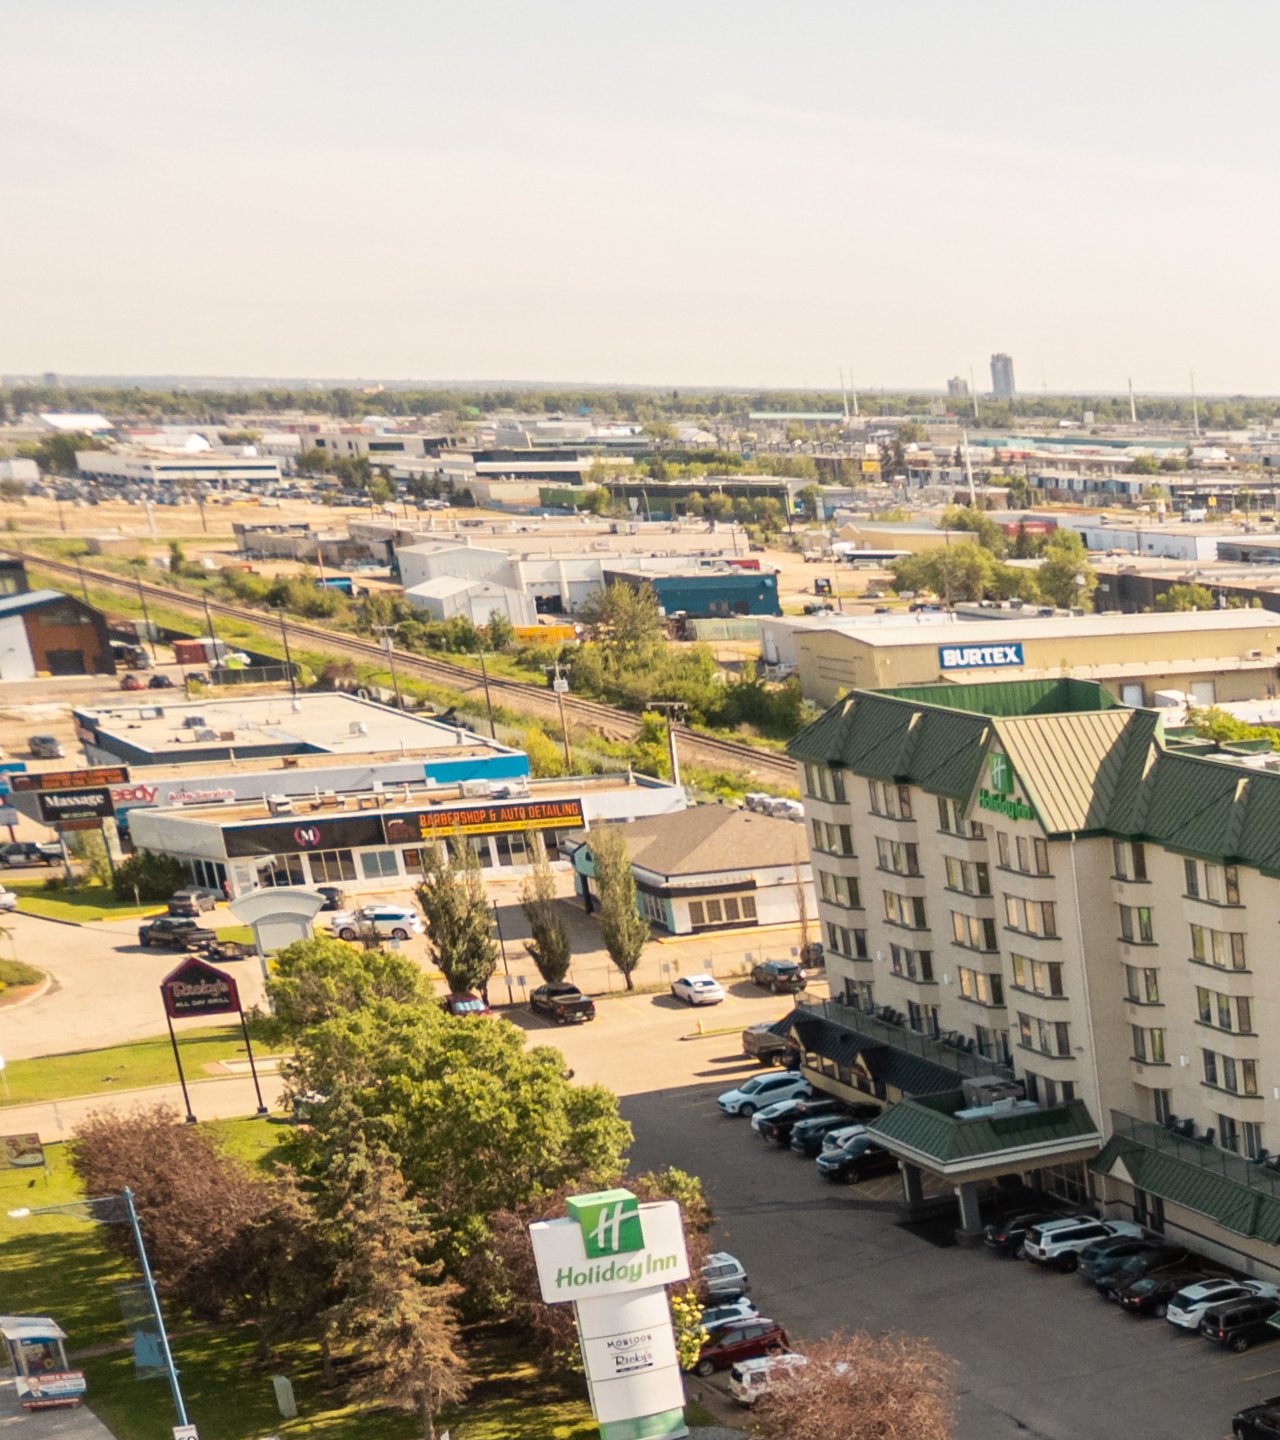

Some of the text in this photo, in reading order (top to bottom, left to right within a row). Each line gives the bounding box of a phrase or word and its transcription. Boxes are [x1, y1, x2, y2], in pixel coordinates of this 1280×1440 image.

[943, 646, 1020, 666] BURTEX
[44, 794, 105, 808] Massage
[111, 784, 236, 803] eedy Auto Service
[419, 802, 579, 827] BARBERSHOP & AUTO DETAILING
[979, 789, 1034, 820] Holiday Inn
[555, 1253, 678, 1289] Holiday Inn
[607, 1334, 652, 1350] MONSOON
